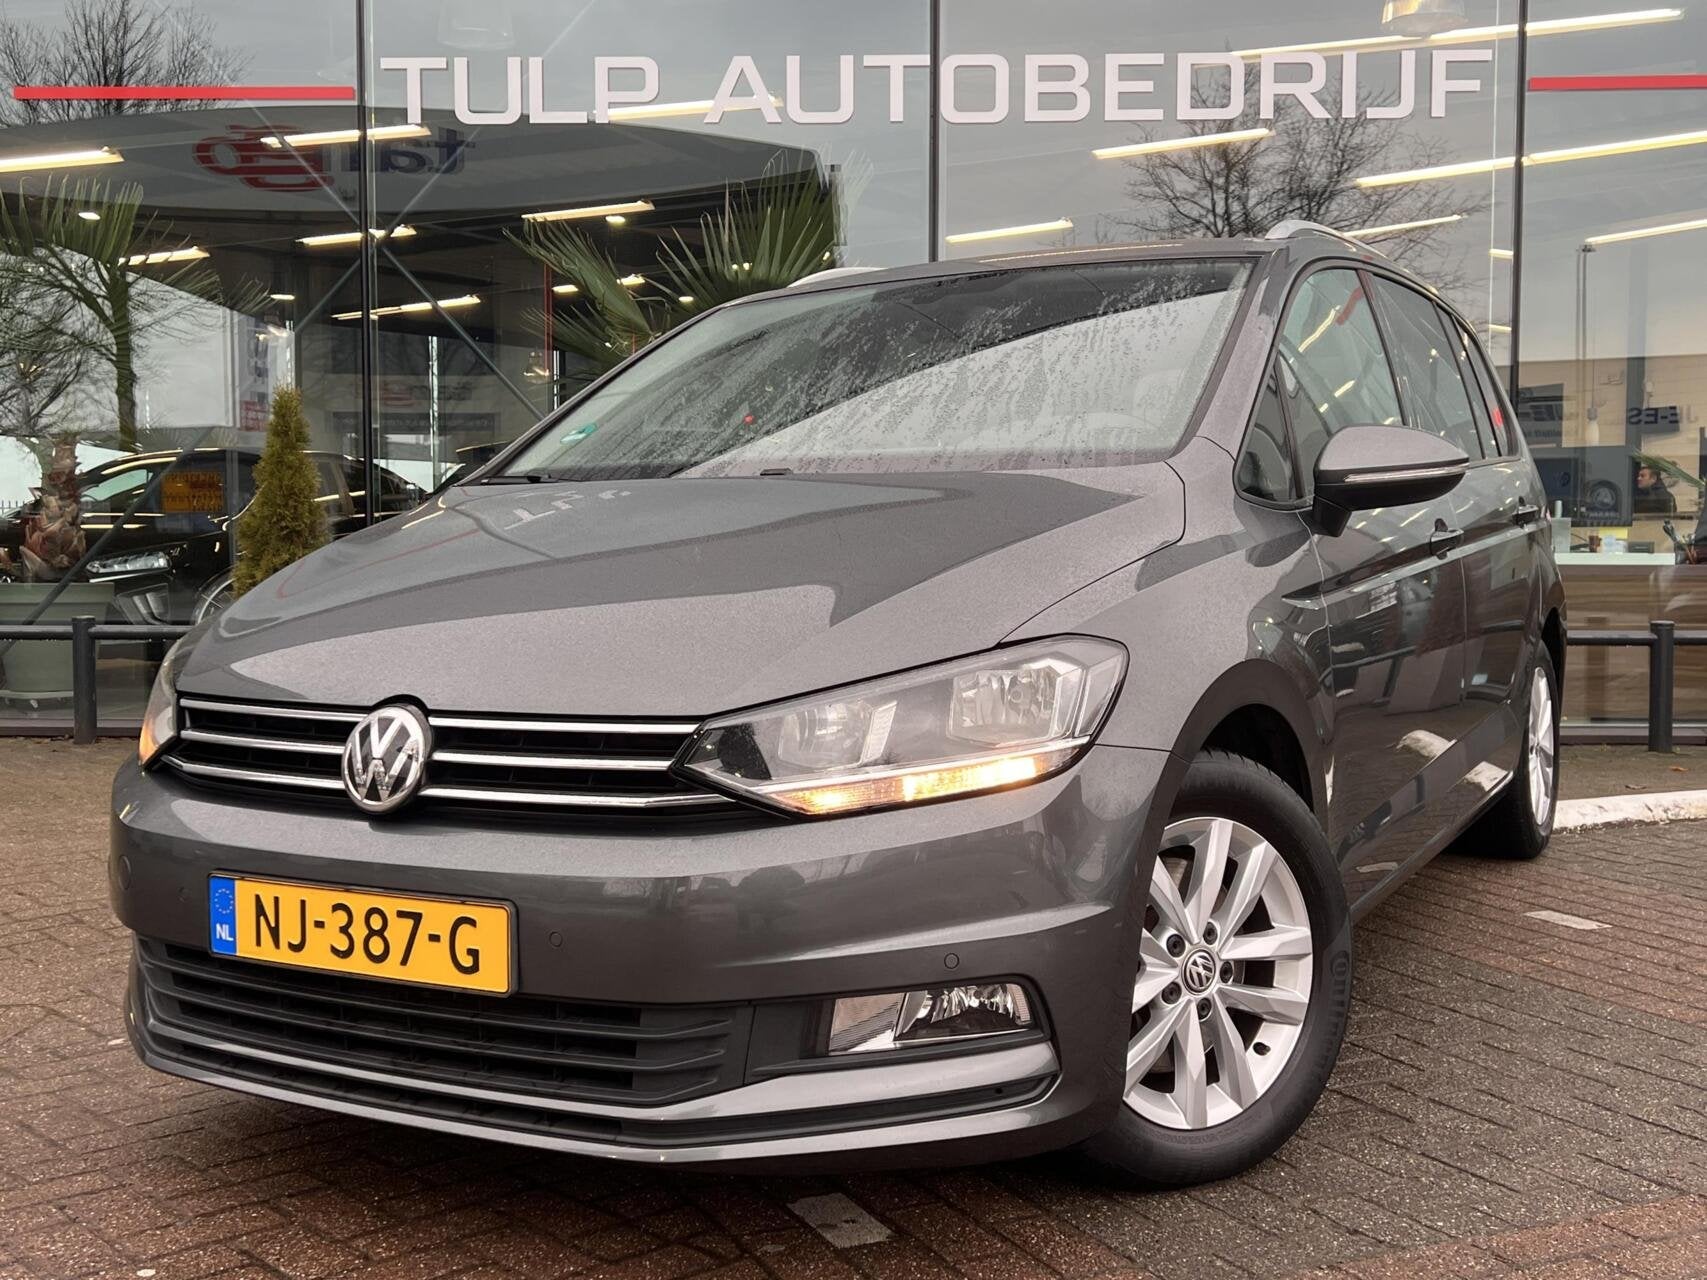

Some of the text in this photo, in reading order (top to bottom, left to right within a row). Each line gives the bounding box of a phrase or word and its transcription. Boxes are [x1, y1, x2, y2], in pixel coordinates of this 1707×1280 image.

[380, 48, 1493, 125] TULP AUTOBEDRIJF
[215, 923, 234, 942] NL
[254, 893, 480, 975] NJ-387-G
